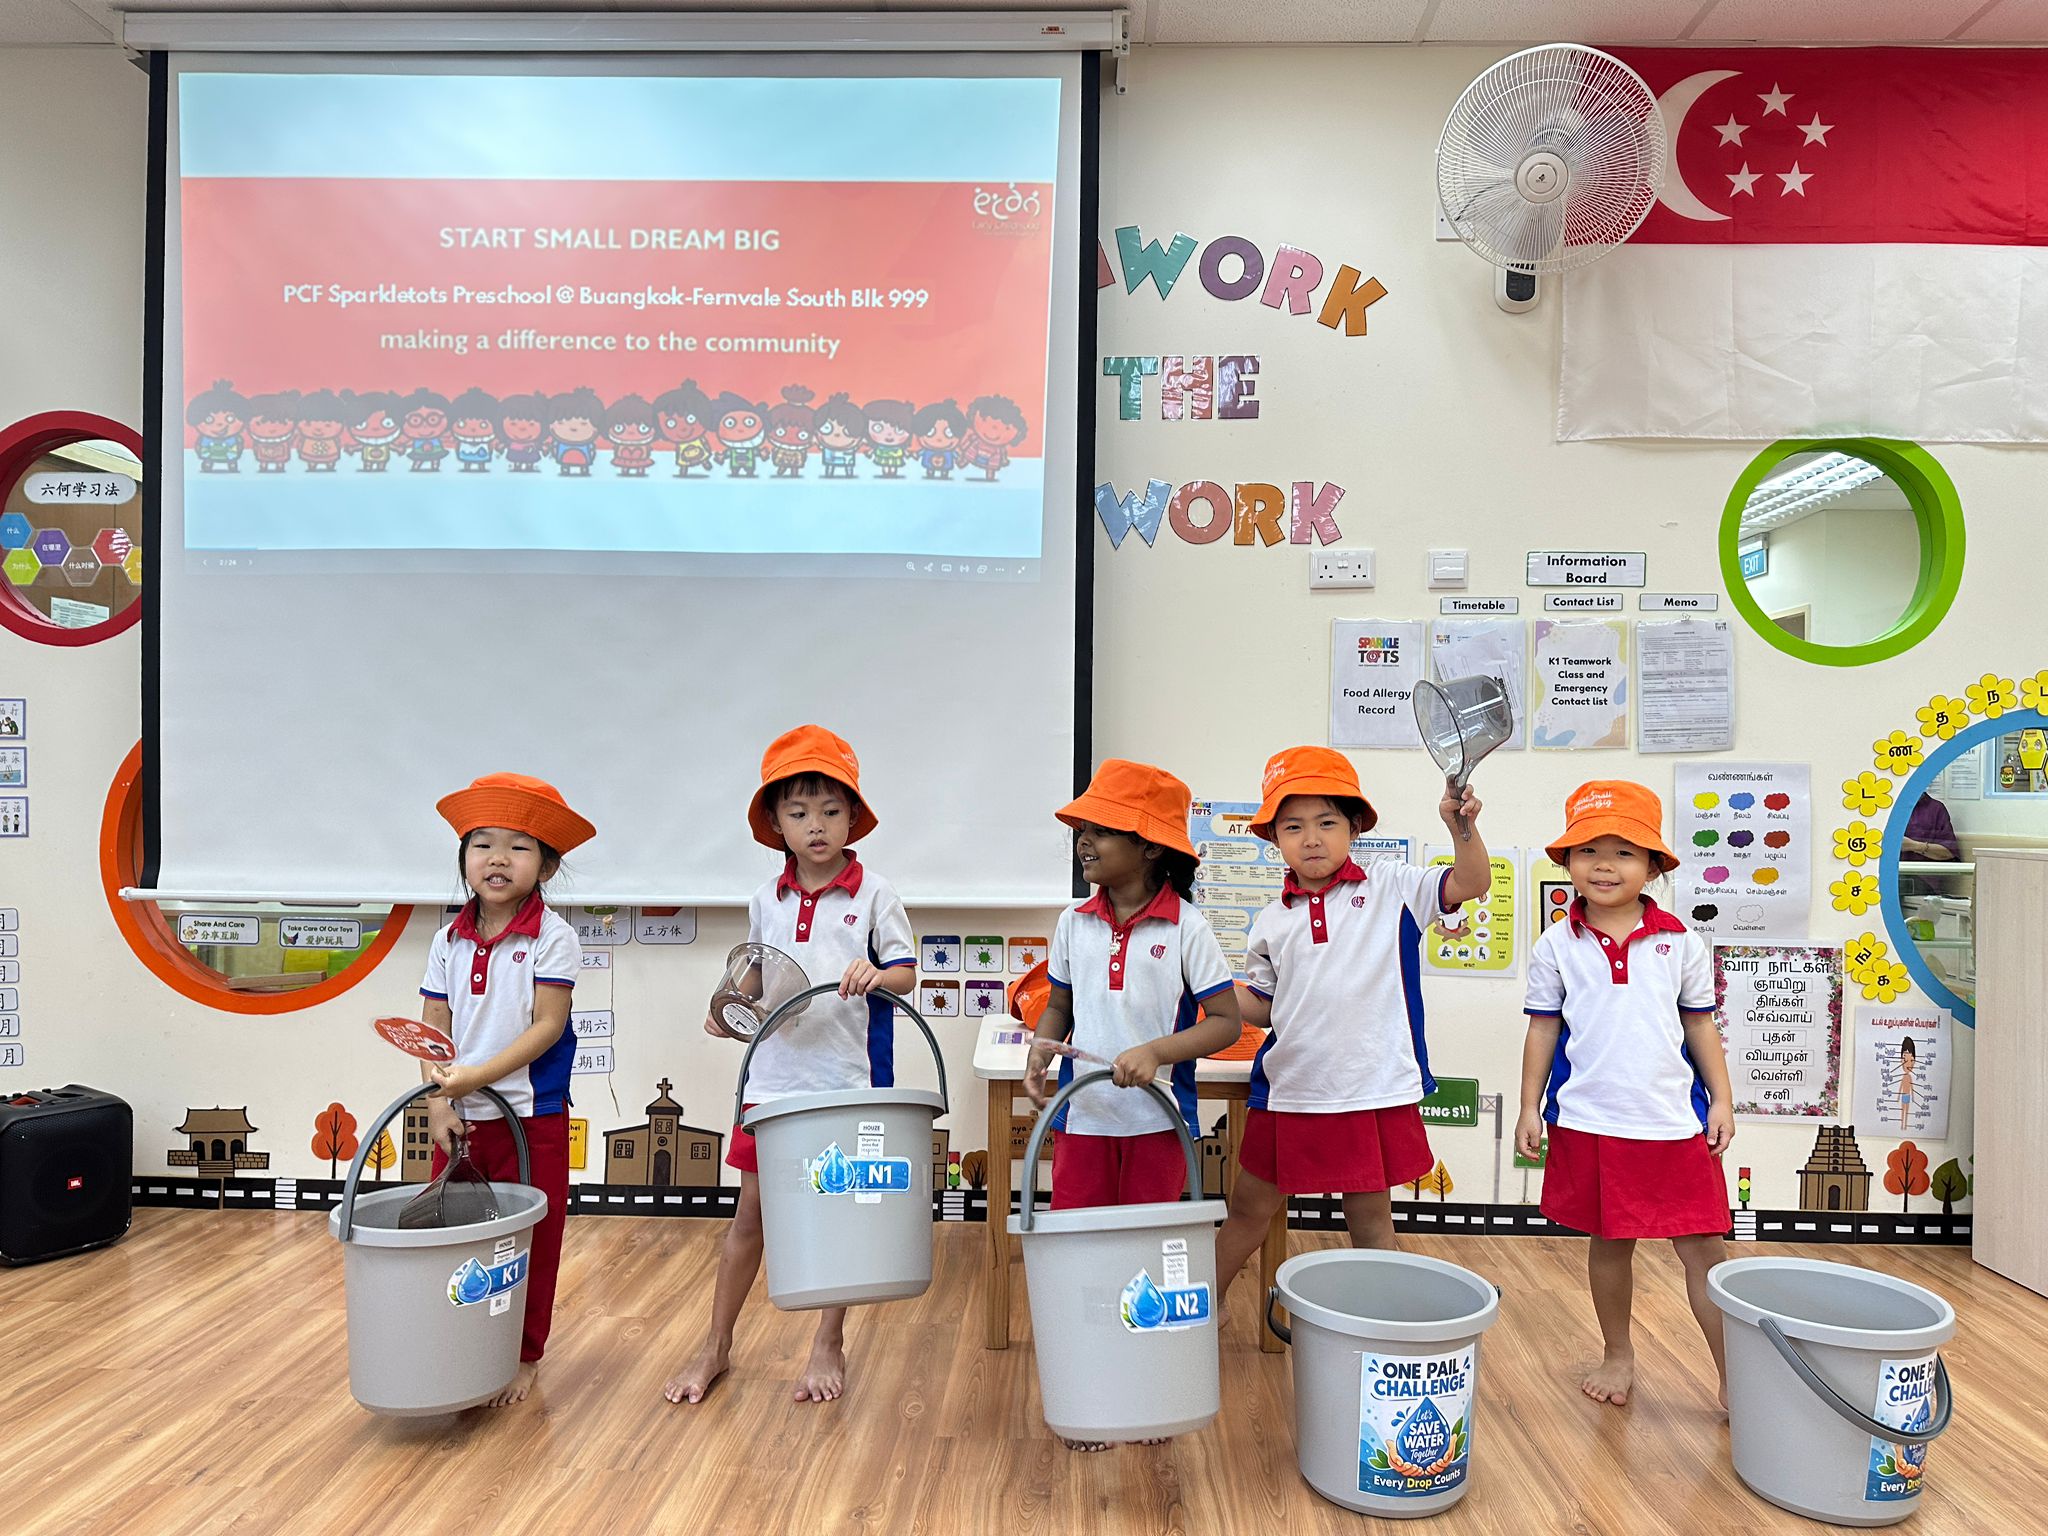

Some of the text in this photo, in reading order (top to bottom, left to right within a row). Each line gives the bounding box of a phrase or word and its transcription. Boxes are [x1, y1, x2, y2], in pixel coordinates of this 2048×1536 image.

[439, 227, 781, 250] START SMALL DREAM BIG
[1097, 225, 1388, 337] WORK
[283, 283, 929, 310] PCF Sparkletots Preschool @ Buangkok-Fernvale South Blk 999
[380, 329, 841, 359] making a difference to the community
[1103, 356, 1260, 421] THE
[41, 481, 120, 498] 六何学习法
[1094, 479, 1346, 551] WORK
[1547, 555, 1627, 567] Information
[1744, 554, 1760, 575] EXIT
[1566, 572, 1607, 584] Board
[1452, 600, 1506, 611] Timetable
[1553, 597, 1614, 607] Contact List
[1663, 598, 1698, 607] Memo
[1358, 637, 1399, 649] SPARKLE
[1548, 657, 1612, 666] K1 Teamwork
[1558, 670, 1605, 679] Class and
[1343, 688, 1411, 701] Food Allergy
[1554, 684, 1608, 694] Emergency
[1551, 697, 1608, 706] Contact list
[1987, 689, 2000, 704] ந
[1358, 705, 1395, 715] Record
[1936, 711, 1949, 729] த
[1888, 746, 1913, 758] ண
[1707, 772, 1773, 782] வண்ணங்கள்
[1350, 840, 1397, 849] ments of Art
[1847, 838, 1866, 852] ஞ
[1491, 862, 1506, 870] ning
[1851, 886, 1862, 897] ச
[193, 920, 212, 928] Share
[213, 920, 227, 928] And
[340, 926, 353, 934] Toys
[201, 930, 239, 941] 分享互助
[643, 925, 682, 938] 正方体
[305, 935, 344, 946] 爱护玩具
[1724, 959, 1829, 976] வார நாட்கள்
[1753, 978, 1806, 994] ஞாயிறு
[1877, 975, 1890, 986] க
[1756, 994, 1804, 1010] திங்கள்
[1746, 1009, 1812, 1024] செவ்வாய்
[573, 1019, 608, 1034] 期六
[1762, 1030, 1795, 1046] புதன்
[3, 1048, 14, 1065] 月
[572, 1055, 606, 1068] 期日
[1745, 1050, 1808, 1066] வியாழன்
[1751, 1068, 1803, 1082] வெள்ளி
[1763, 1087, 1790, 1101] சனி
[868, 1164, 892, 1184] N1
[502, 1261, 519, 1286] K1
[1175, 1292, 1199, 1317] N2
[1382, 1358, 1460, 1380] ONE PAIL
[1899, 1364, 1925, 1383] ONE
[1374, 1372, 1465, 1397] CHALLENGE
[1889, 1379, 1934, 1402] CHALLE
[1416, 1409, 1433, 1421] Let's
[1409, 1420, 1441, 1435] SAVE
[1403, 1434, 1444, 1449] WATER
[1410, 1447, 1439, 1463] Together
[1374, 1468, 1461, 1490] Every Drop Counts
[1881, 1481, 1905, 1494] Every
